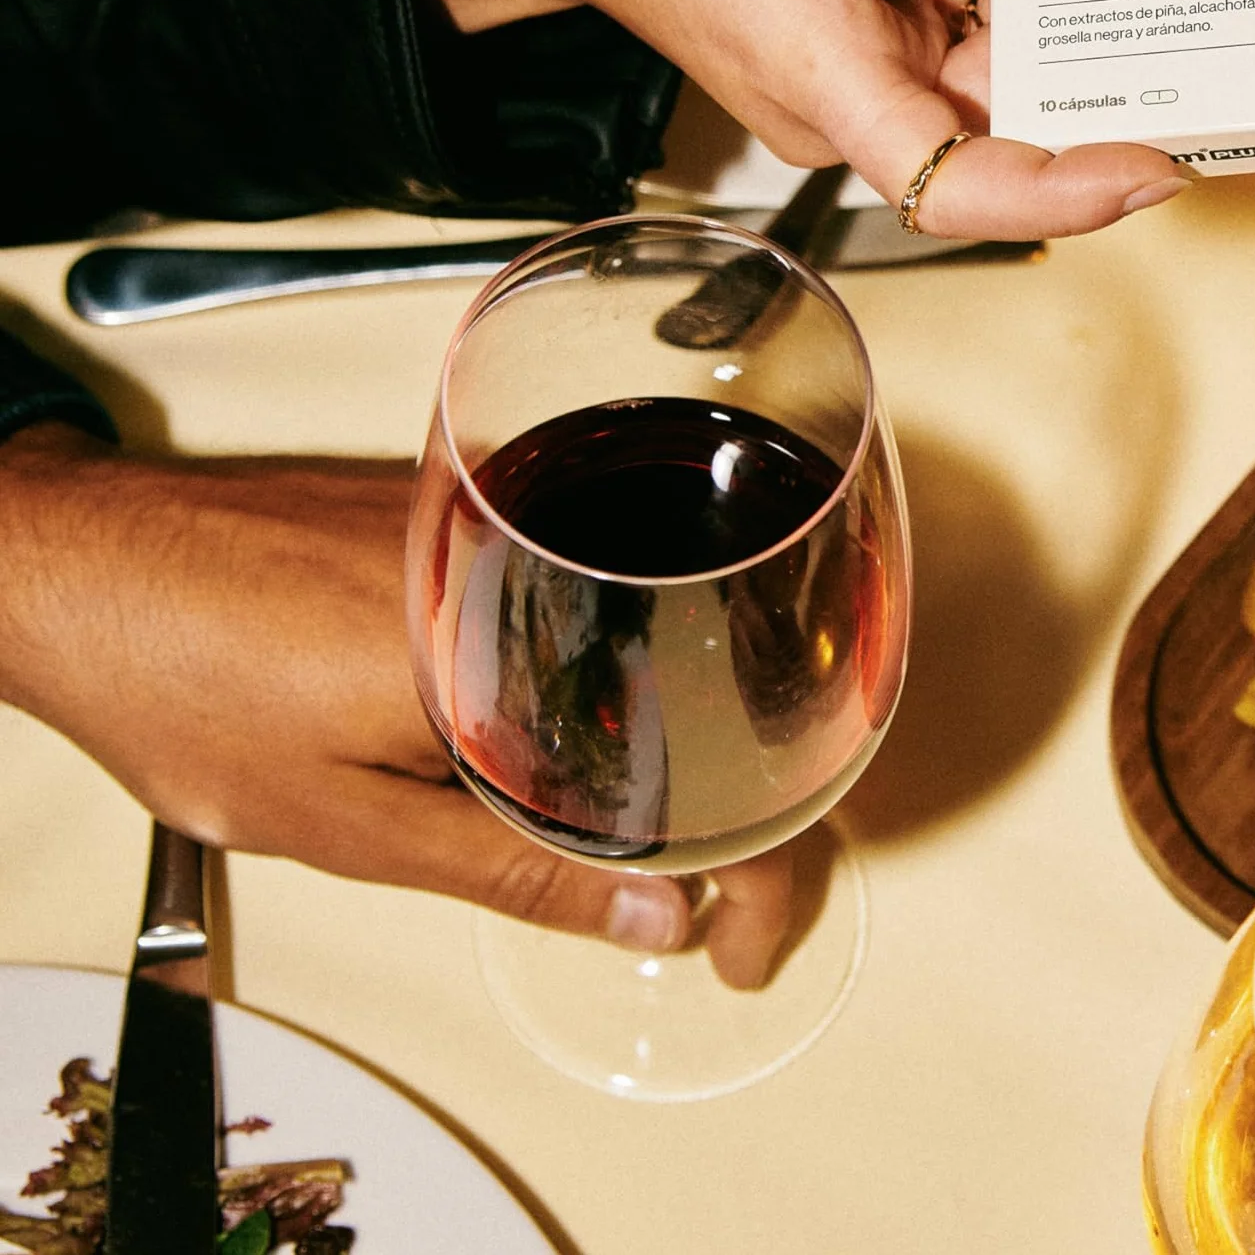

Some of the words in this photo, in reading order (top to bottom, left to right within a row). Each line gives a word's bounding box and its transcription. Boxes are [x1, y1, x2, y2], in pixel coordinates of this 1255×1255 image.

[1038, 15, 1067, 29] Con
[1068, 9, 1134, 26] extractos
[1135, 6, 1154, 20] de
[1155, 3, 1187, 20] piña,
[1038, 31, 1093, 50] grosella
[1094, 26, 1134, 43] negra
[1135, 27, 1144, 40] y
[1145, 21, 1215, 37] arándano.
[1038, 99, 1057, 113] 10
[1058, 94, 1127, 113] cápsulas
